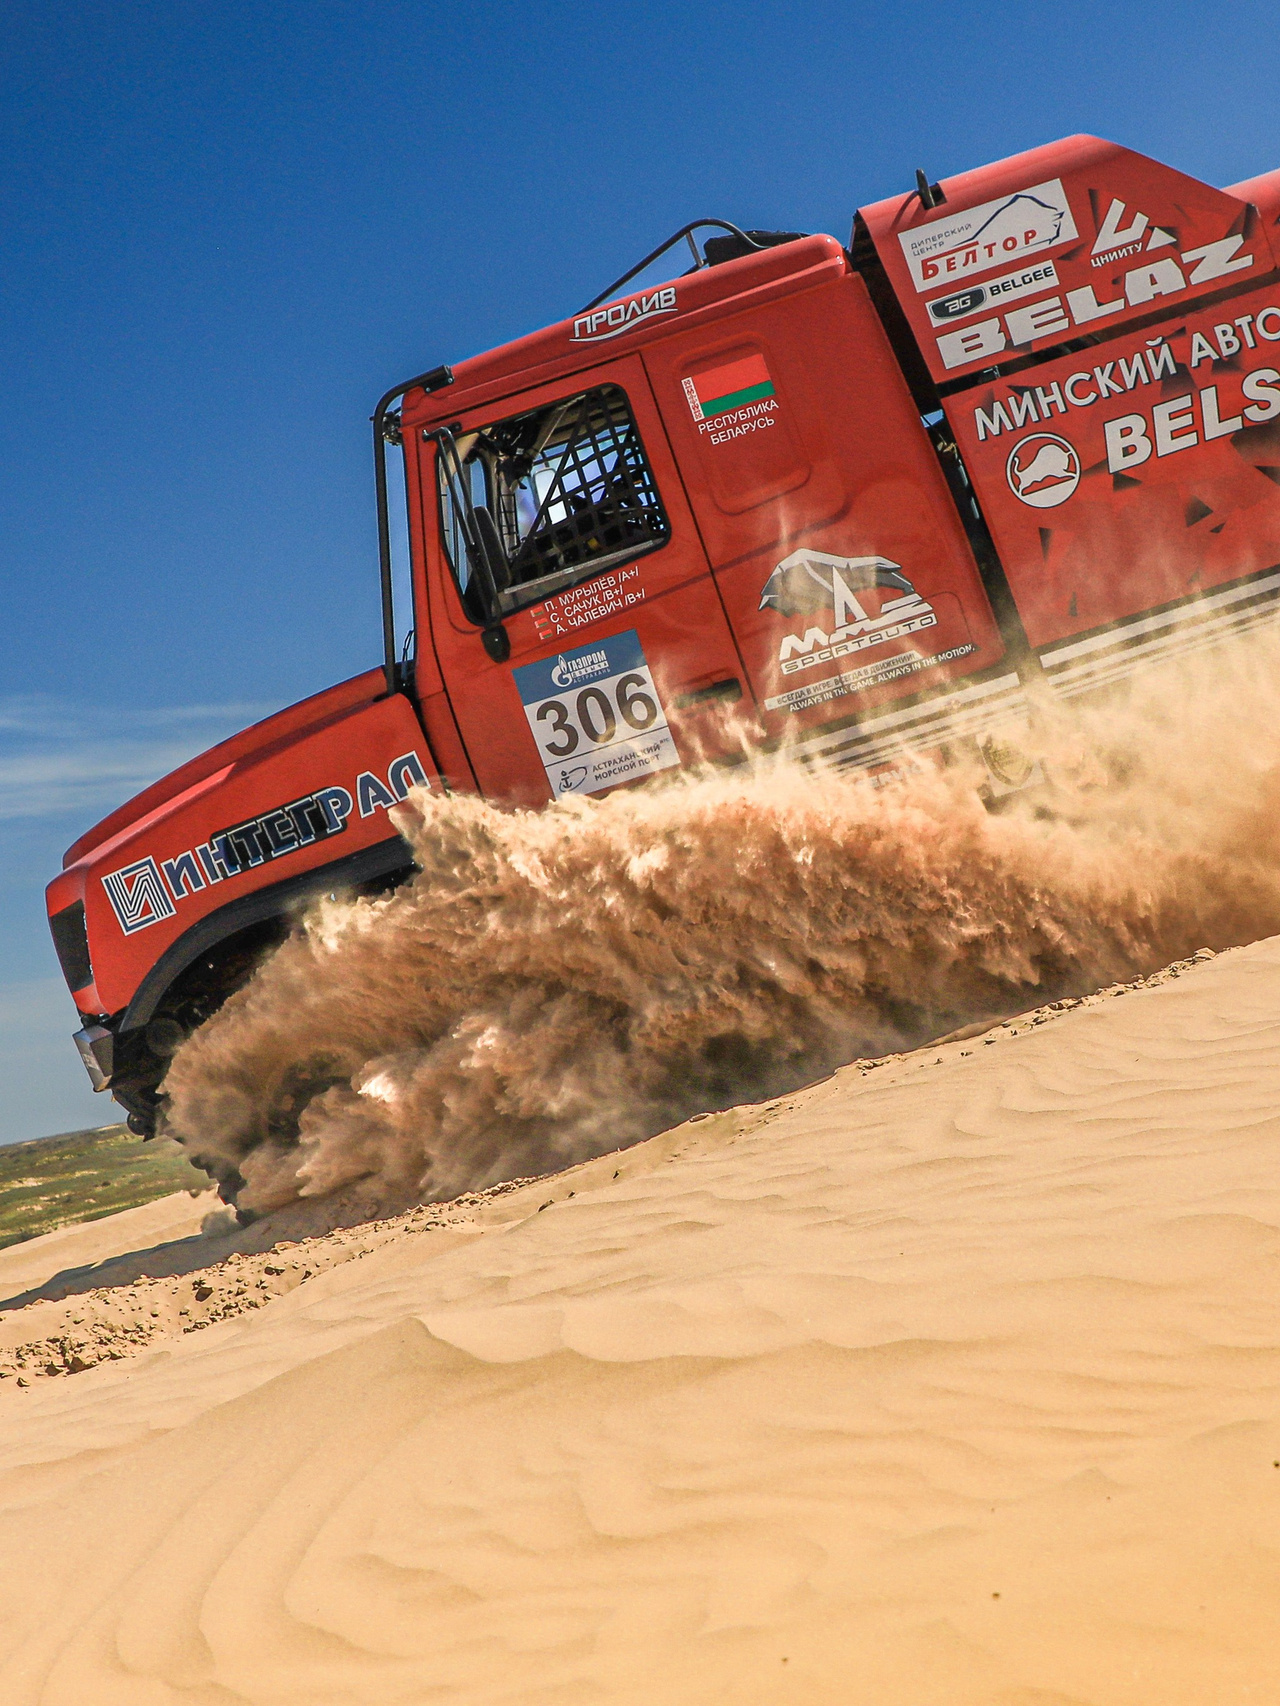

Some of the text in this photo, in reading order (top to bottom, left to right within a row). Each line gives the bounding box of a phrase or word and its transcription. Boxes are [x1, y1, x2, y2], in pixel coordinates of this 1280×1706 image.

[911, 222, 972, 250] ДИЛЕРСКИЙ
[913, 241, 945, 257] ЦЕНТР
[921, 229, 1037, 280] БЕЛТОР
[1090, 243, 1145, 268] ЦНИИТУ
[989, 266, 1054, 296] BELGEE
[573, 286, 677, 339] ПРОЛИВ
[936, 233, 1254, 370] BELAZ
[973, 337, 1178, 442] МИНСКИЙ
[697, 399, 780, 435] РЕСПУБЛИКА
[710, 416, 775, 446] БЕЛАРУСЬ
[544, 600, 558, 613] П.
[558, 576, 616, 607] МУРЫЛЁВ
[550, 612, 563, 623] С.
[564, 595, 602, 617] САЧУК
[556, 624, 568, 635] А.
[568, 598, 624, 627] ЧАЛЕВИЧ
[567, 650, 607, 672] ГАЗПРОМ
[784, 616, 934, 673] SPORTAUTO
[571, 661, 609, 678] ДОБЫЧА
[573, 668, 611, 684] АСТРАХАНЬ
[789, 697, 822, 712] ALWAYS
[823, 691, 833, 701] IN
[850, 677, 877, 691] GAME.
[878, 666, 911, 682] ALWAYS
[911, 662, 921, 671] IN
[922, 655, 938, 668] THE
[536, 673, 658, 757] 306
[594, 761, 637, 781] МОРСКОЙ
[160, 750, 432, 901] ИНТЕГРАЛ
